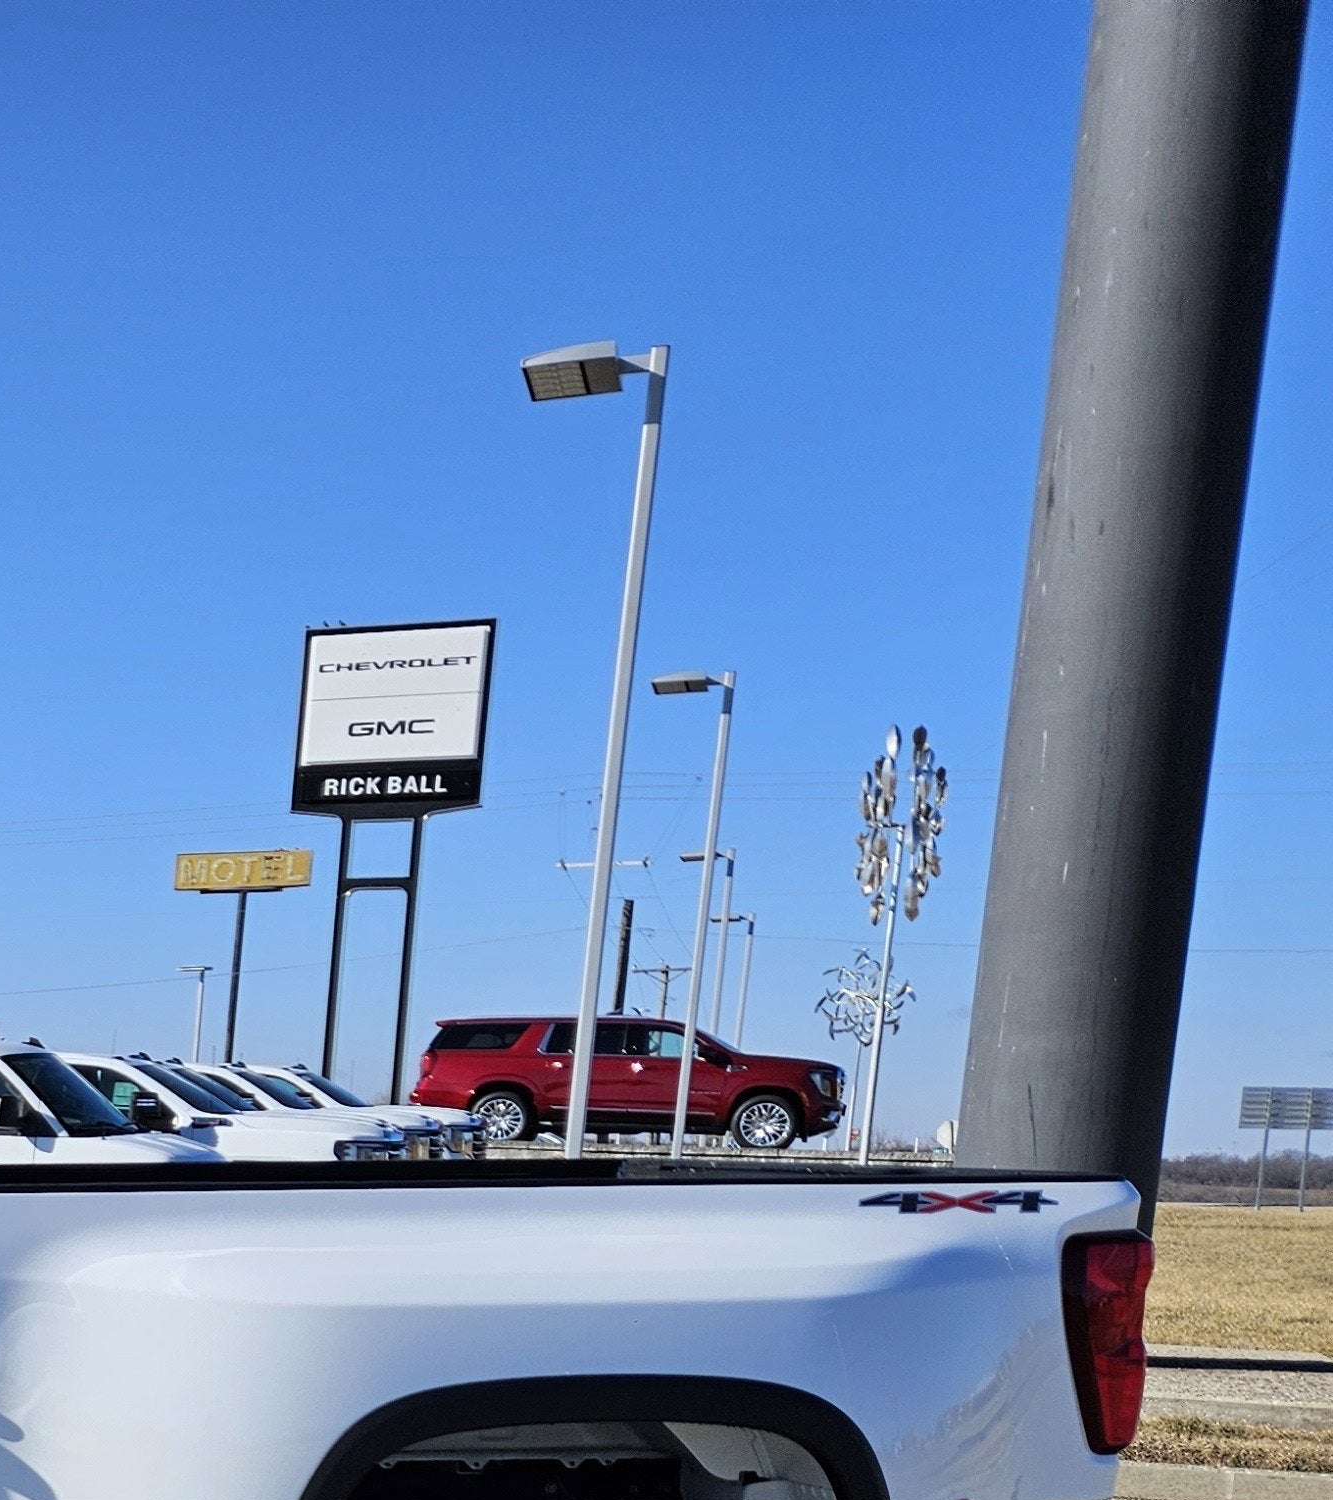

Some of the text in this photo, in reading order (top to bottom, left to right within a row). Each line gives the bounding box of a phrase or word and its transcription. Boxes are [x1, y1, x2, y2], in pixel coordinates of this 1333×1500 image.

[318, 655, 477, 674] CHEVROLET
[348, 718, 435, 737] GMC
[323, 775, 448, 796] RICK BALL
[180, 854, 307, 885] MOTEL
[859, 1190, 1059, 1214] 4X4
